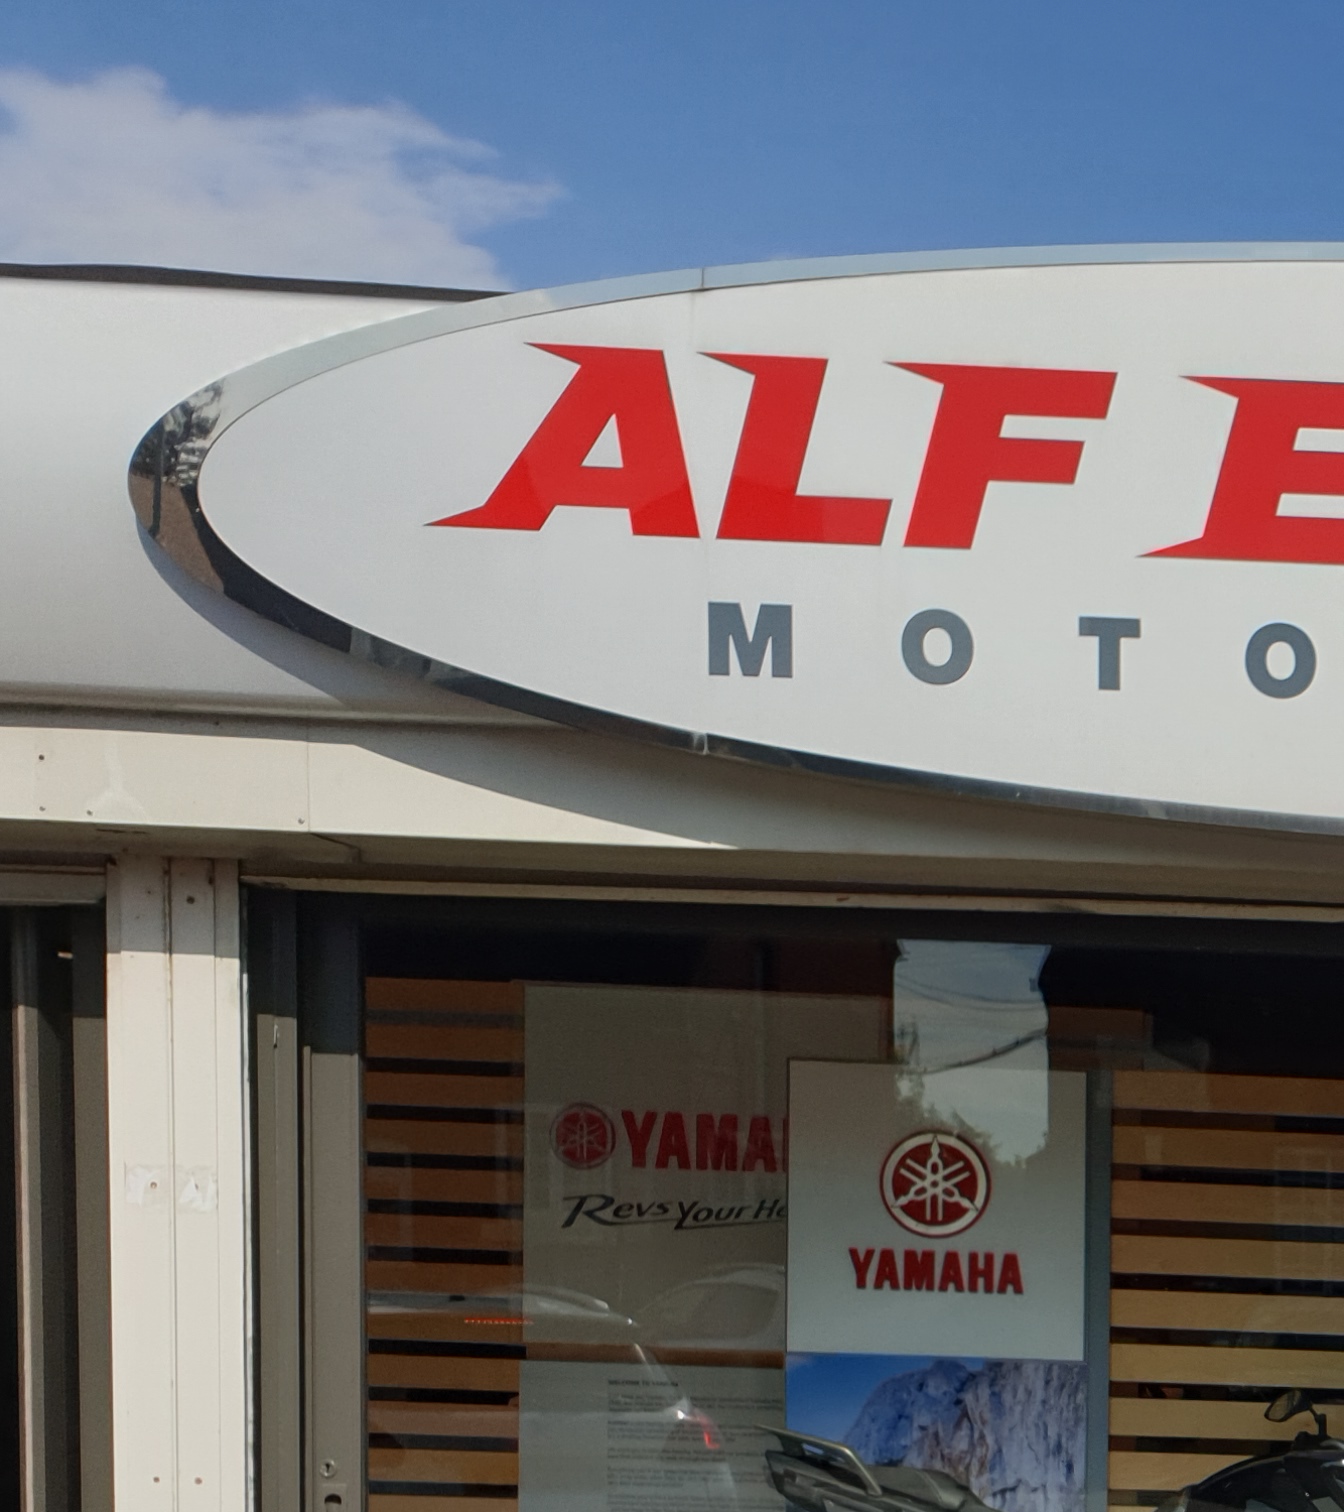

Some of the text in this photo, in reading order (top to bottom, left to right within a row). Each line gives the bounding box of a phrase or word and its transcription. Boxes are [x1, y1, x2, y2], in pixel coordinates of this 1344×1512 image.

[423, 342, 1118, 550] ALF
[621, 1109, 788, 1173] YAMA
[561, 1193, 670, 1230] Revs
[673, 1201, 750, 1231] Your
[848, 1247, 1024, 1295] YAMAHA
